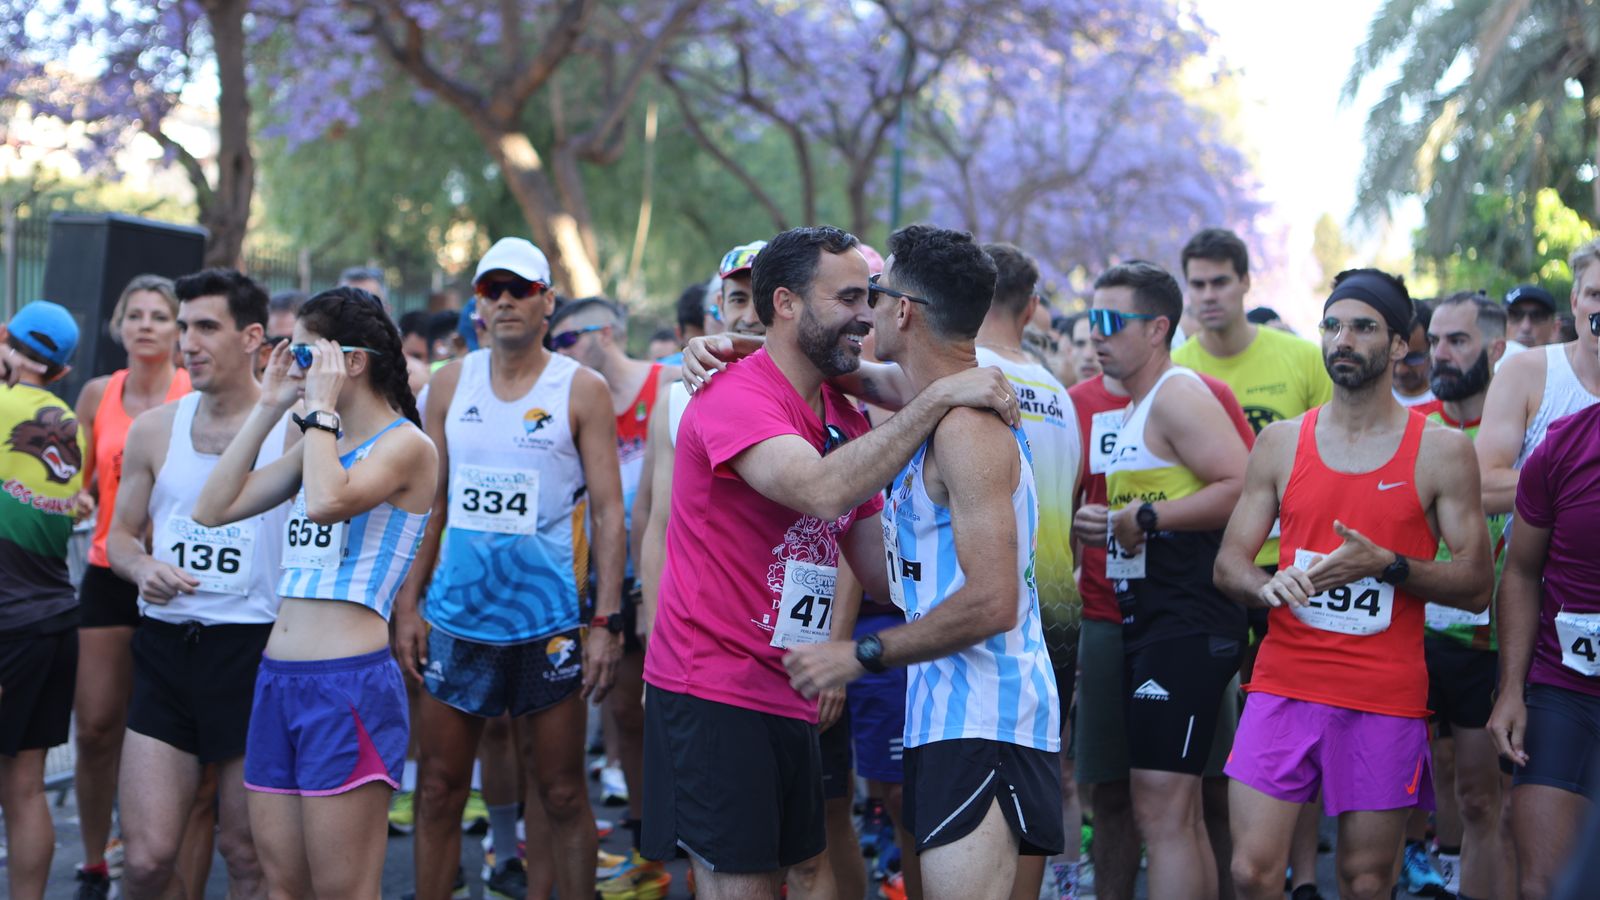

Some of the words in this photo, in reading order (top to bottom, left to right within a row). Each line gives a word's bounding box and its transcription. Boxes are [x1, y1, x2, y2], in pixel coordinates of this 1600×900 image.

[462, 488, 528, 516] 334
[288, 518, 333, 548] 658
[170, 542, 242, 574] 136
[790, 595, 833, 630] 47
[1571, 637, 1600, 662] 4
